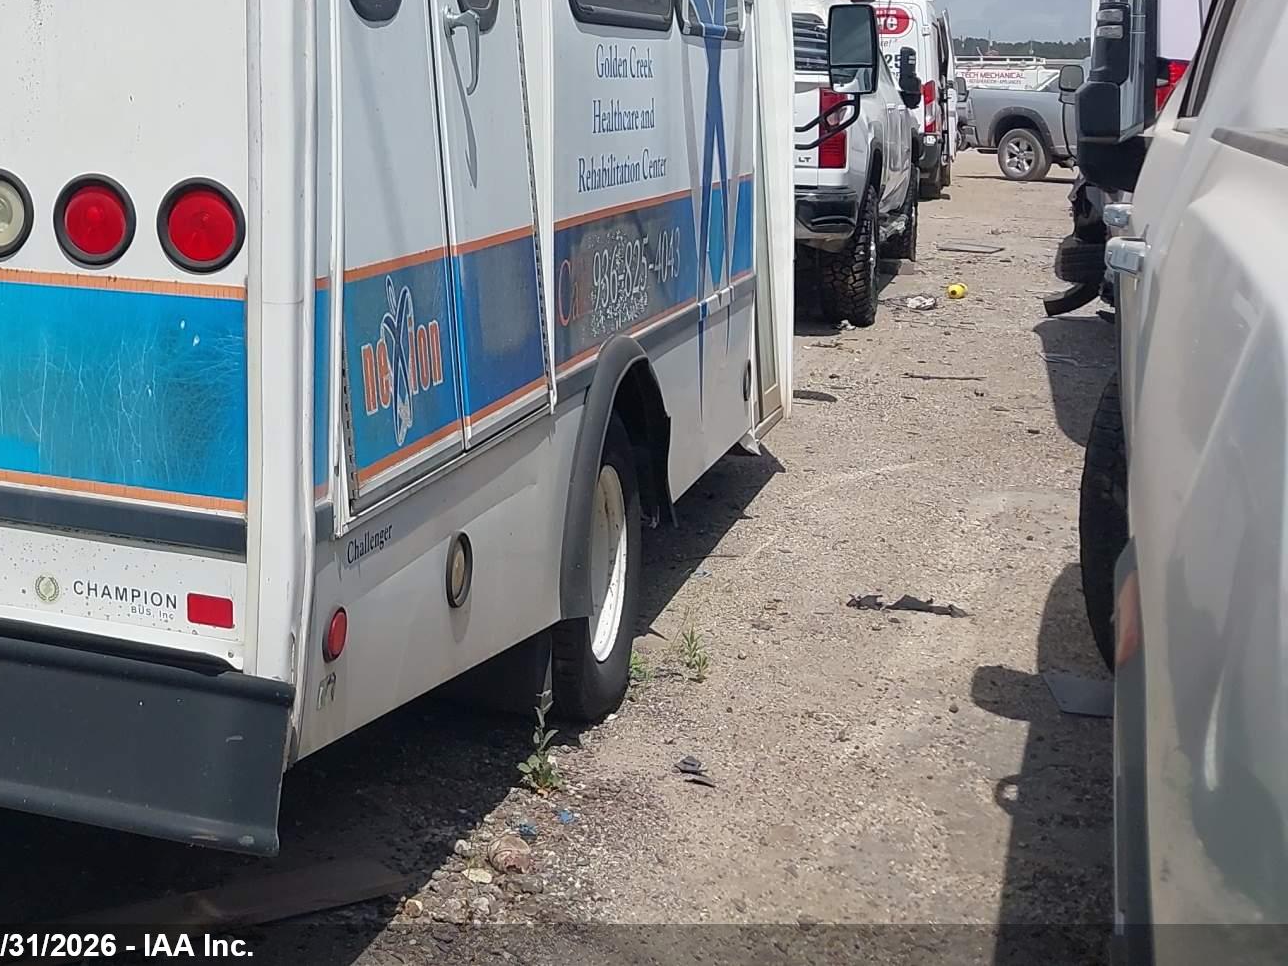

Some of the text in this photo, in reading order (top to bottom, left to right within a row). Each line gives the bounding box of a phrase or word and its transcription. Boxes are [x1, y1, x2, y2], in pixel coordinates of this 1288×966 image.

[596, 43, 654, 79] Golden Creek
[592, 97, 655, 134] Healthcare and
[578, 148, 667, 193] Rehabilitation Center
[593, 226, 680, 313] 936-825-4043
[347, 525, 392, 564] Challenger
[73, 580, 177, 610] CHAMPION
